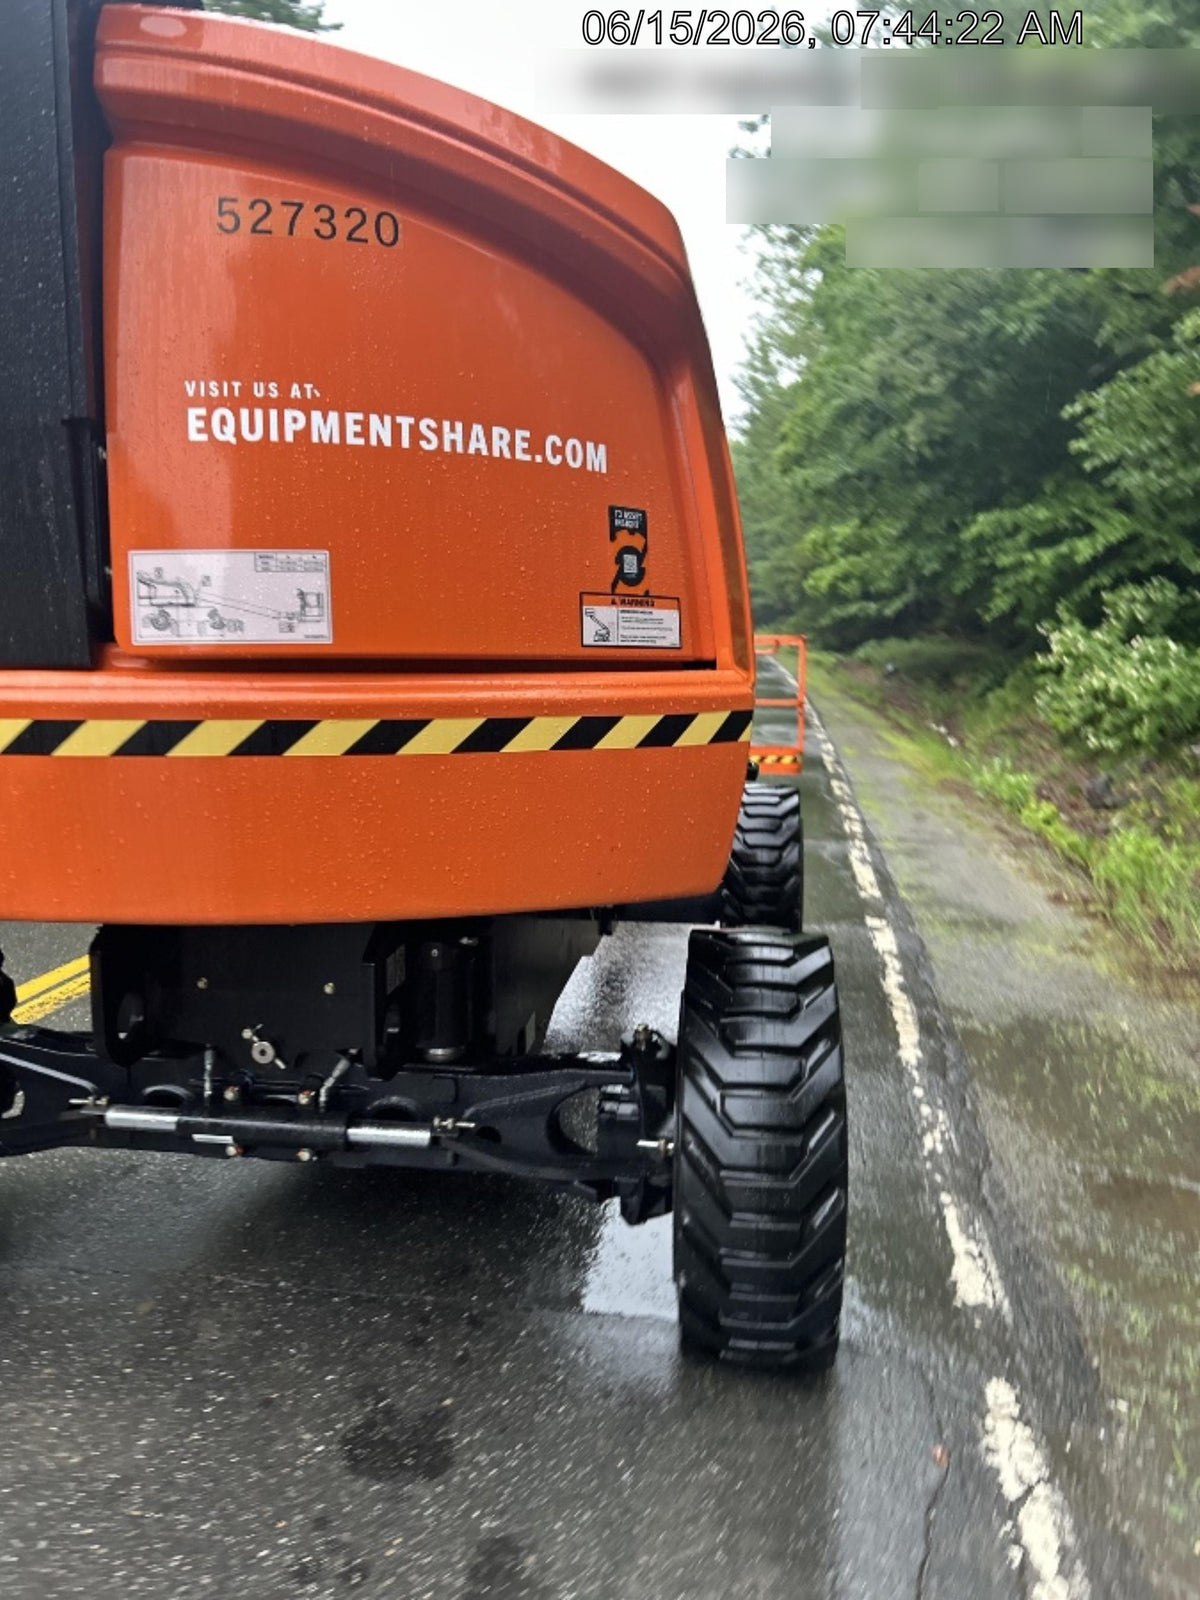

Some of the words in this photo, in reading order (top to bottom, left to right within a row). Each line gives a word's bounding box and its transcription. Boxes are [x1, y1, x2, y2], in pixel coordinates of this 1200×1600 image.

[217, 197, 399, 247] 527320
[185, 380, 242, 398] VISIT
[253, 381, 279, 398] US
[187, 407, 607, 474] EQUIPMENTSHARE.COM
